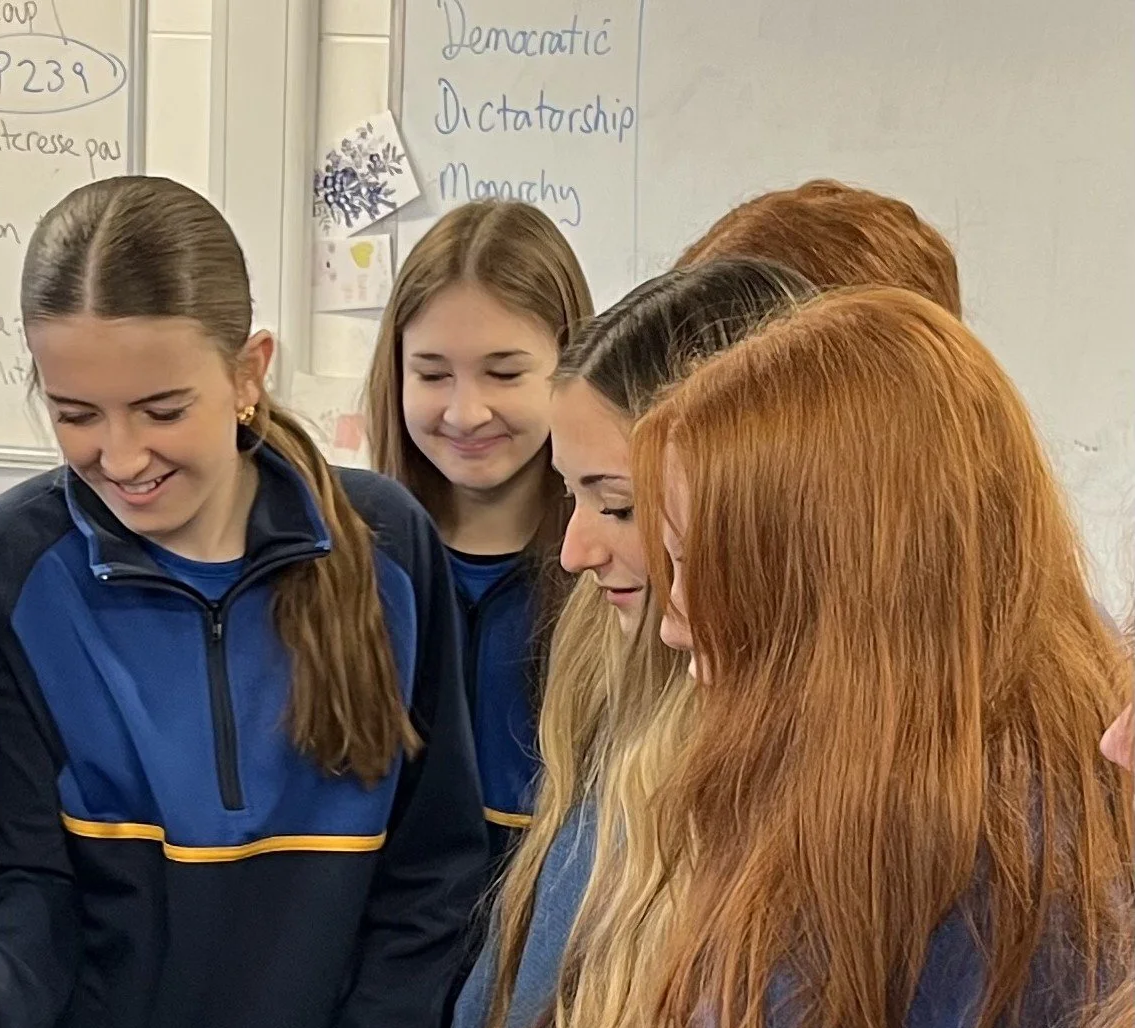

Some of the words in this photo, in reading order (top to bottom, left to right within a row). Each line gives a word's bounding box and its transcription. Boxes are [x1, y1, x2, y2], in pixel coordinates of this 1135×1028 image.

[437, 0, 612, 60] Democratic
[435, 78, 635, 143] Dictatorship
[439, 162, 581, 226] Monarchy
